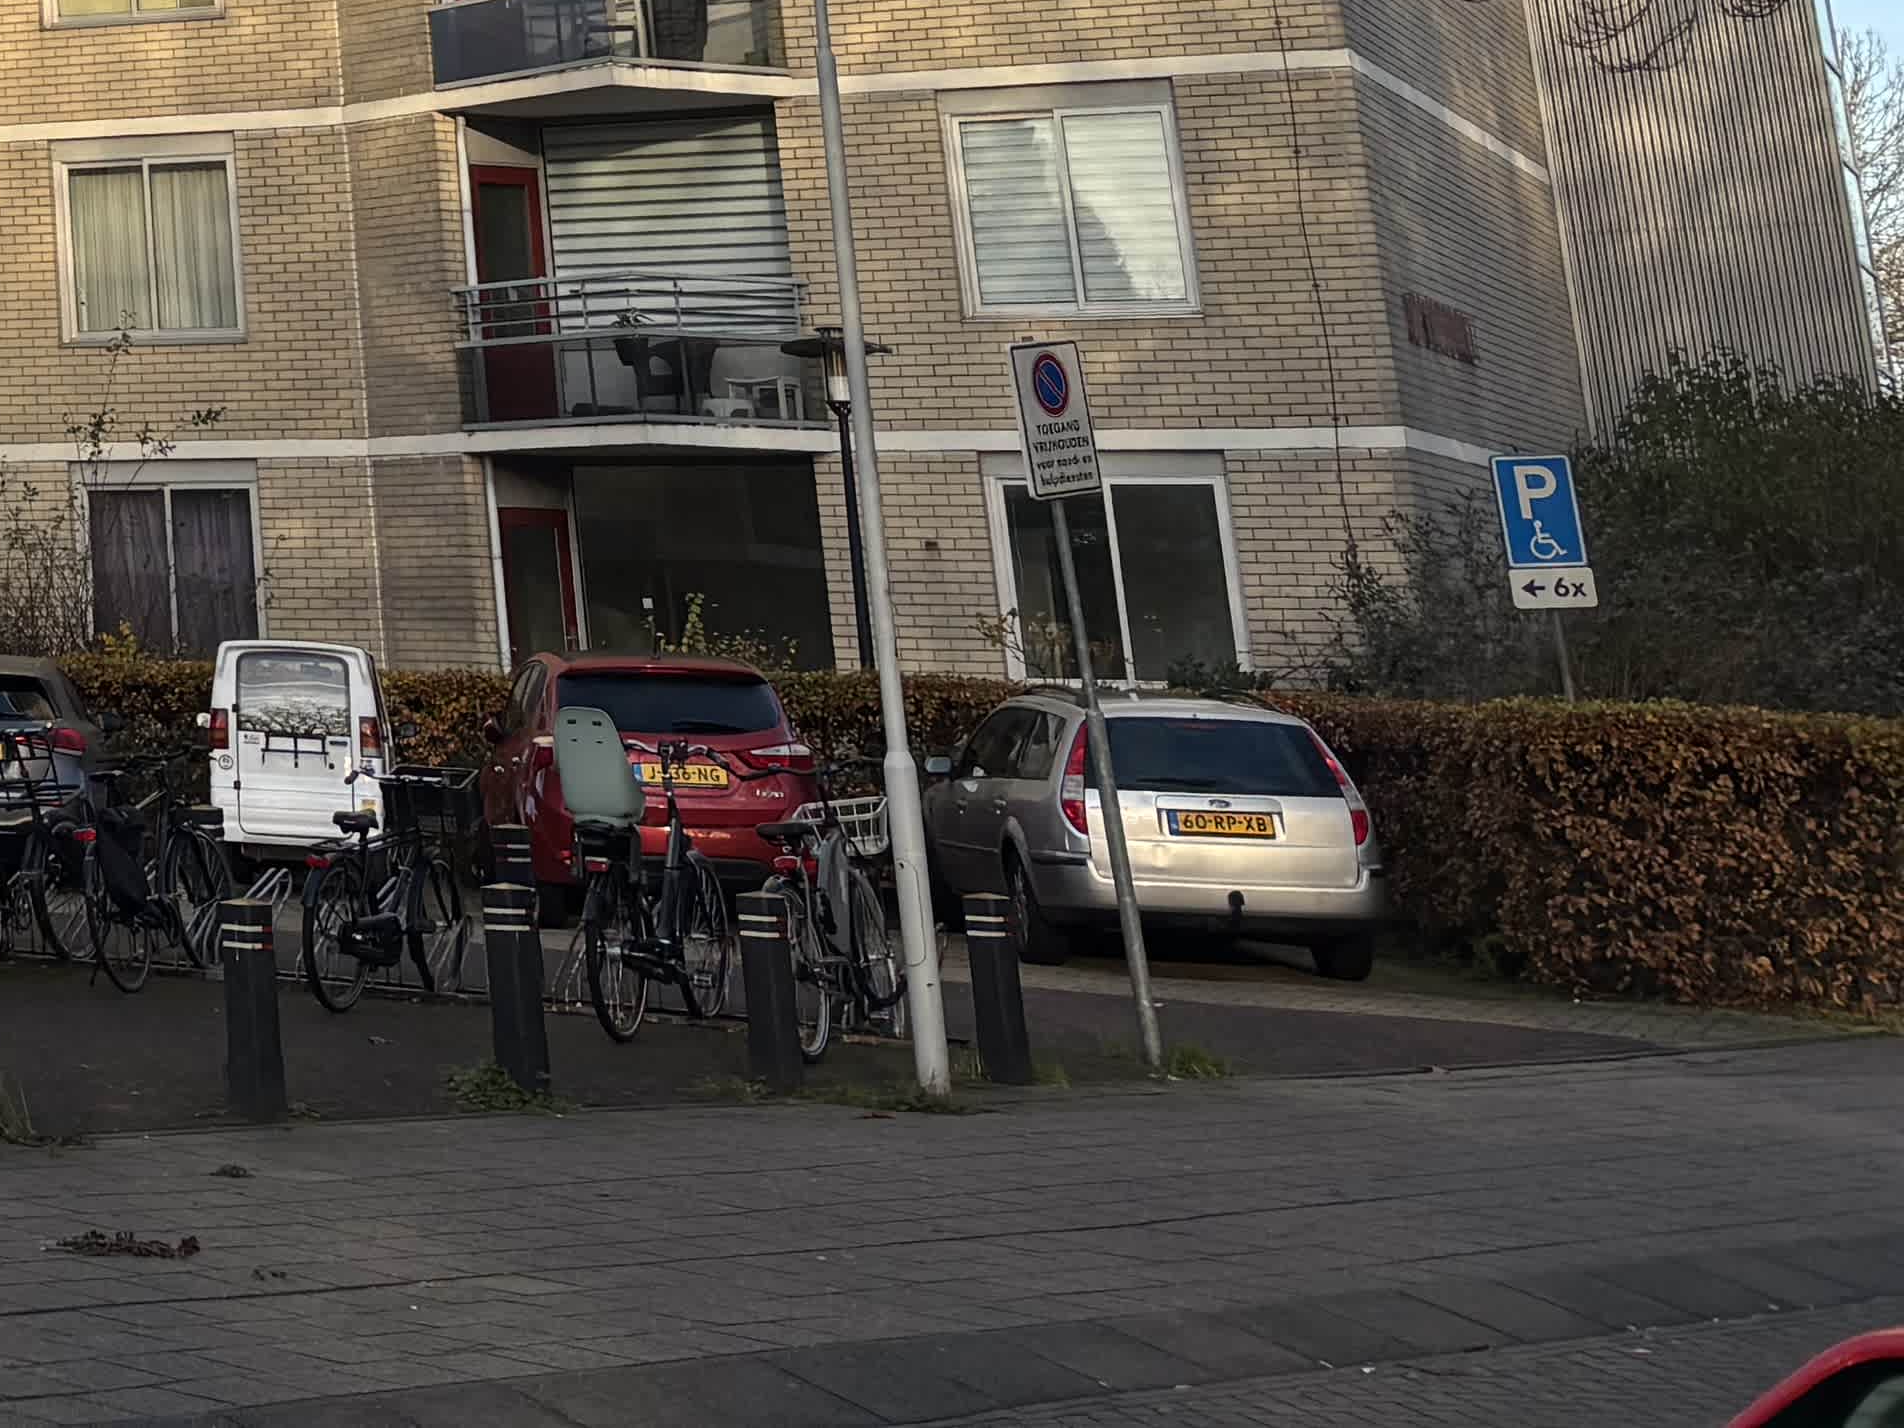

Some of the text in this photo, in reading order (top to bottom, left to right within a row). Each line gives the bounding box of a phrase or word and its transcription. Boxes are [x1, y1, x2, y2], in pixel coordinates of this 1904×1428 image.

[1513, 465, 1557, 520] P
[1554, 576, 1587, 598] 6x
[649, 765, 721, 782] J-36-NG
[1182, 814, 1268, 832] 60-RP-XB
